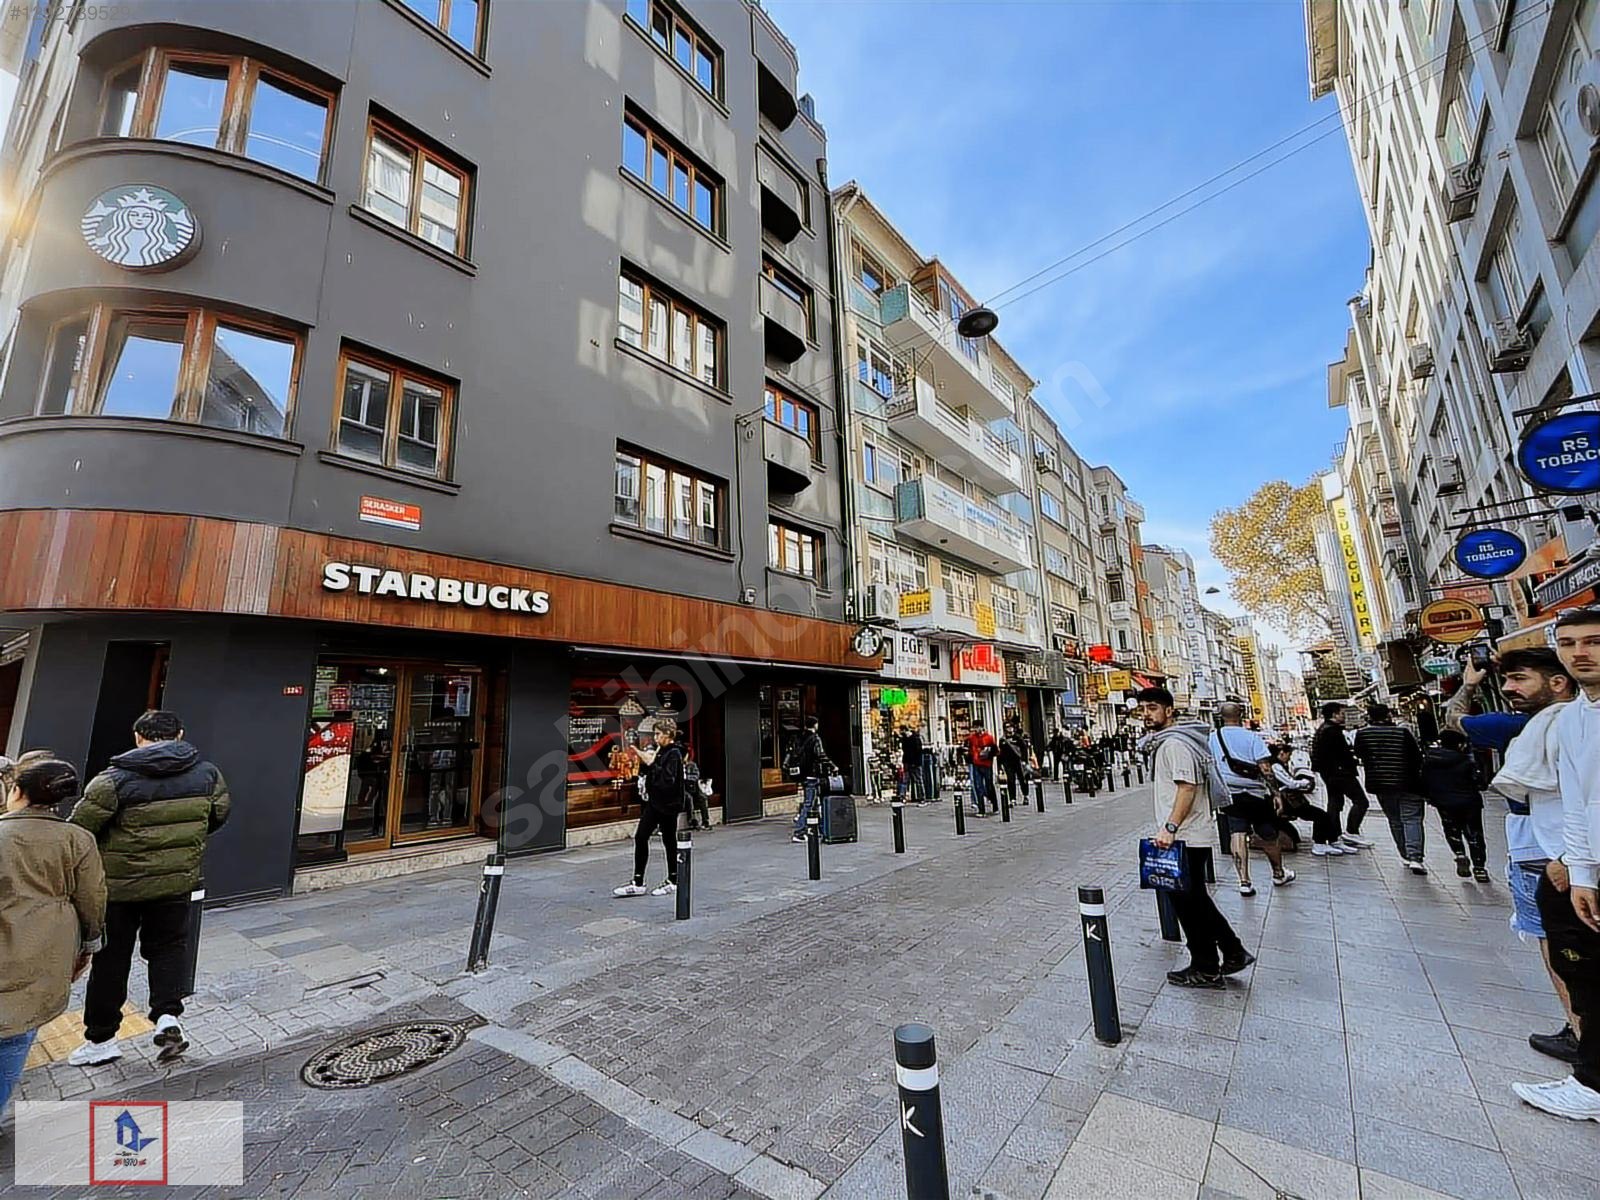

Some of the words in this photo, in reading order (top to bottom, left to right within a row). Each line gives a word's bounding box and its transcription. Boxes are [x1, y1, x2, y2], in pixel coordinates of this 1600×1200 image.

[1562, 437, 1589, 452] RS
[1536, 449, 1600, 469] TOBAC
[1465, 549, 1514, 562] TOBACCO
[1479, 544, 1494, 552] RS
[322, 561, 550, 614] STARBUCKS
[902, 637, 924, 655] EGE
